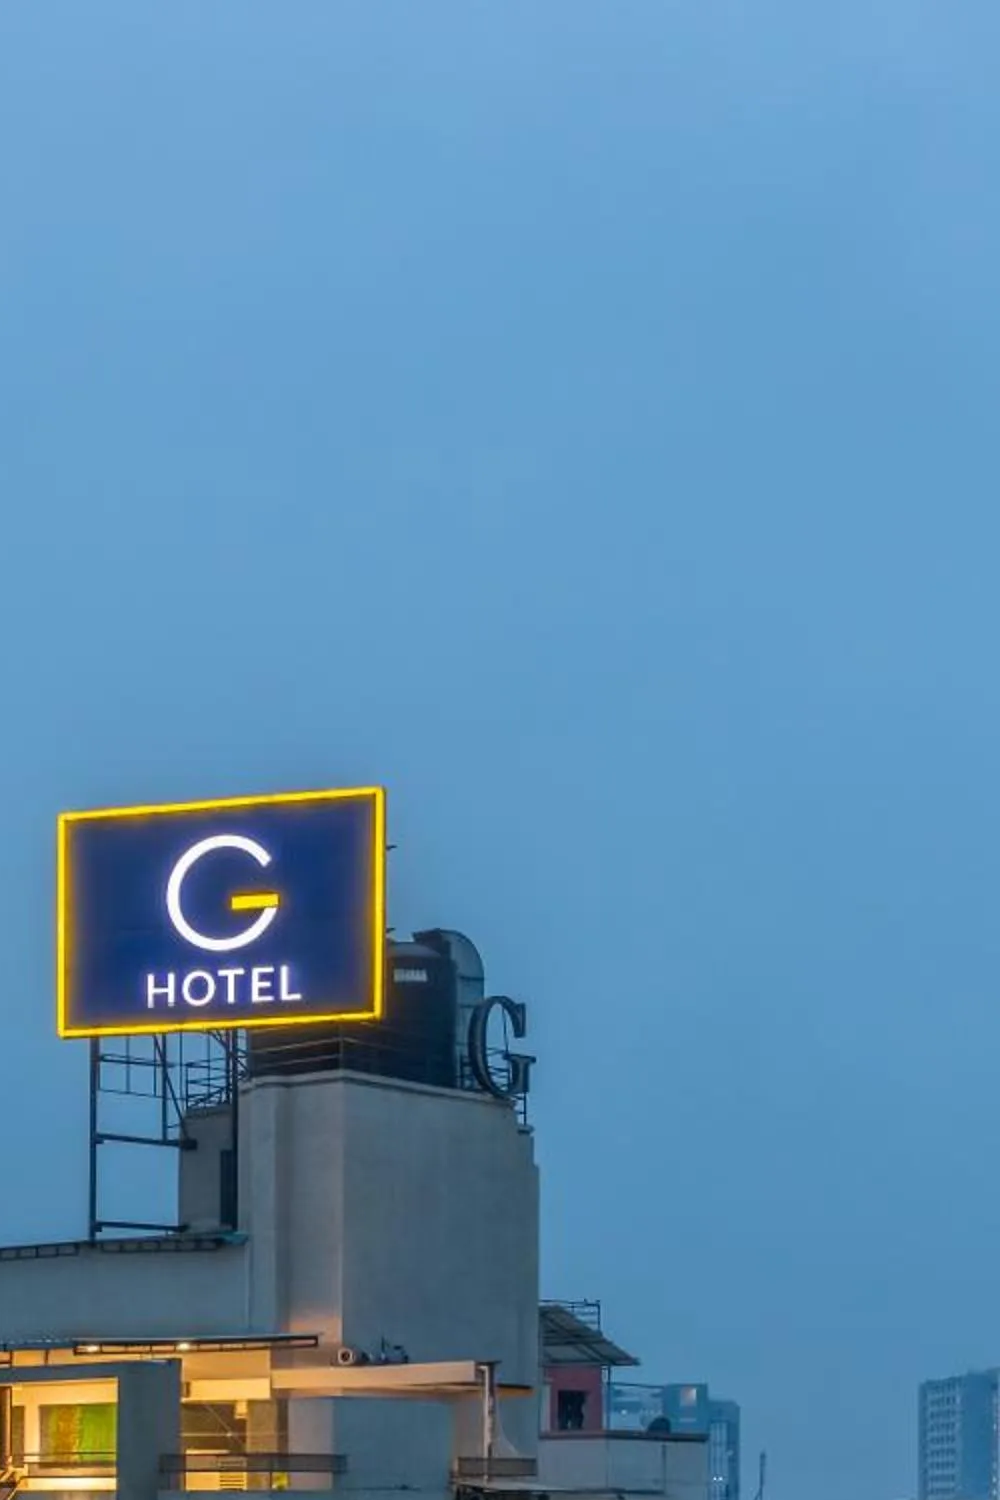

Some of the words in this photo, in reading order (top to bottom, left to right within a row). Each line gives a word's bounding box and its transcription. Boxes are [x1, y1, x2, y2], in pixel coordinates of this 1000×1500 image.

[167, 834, 279, 951] G
[146, 965, 302, 1008] HOTEL
[468, 996, 536, 1097] G
